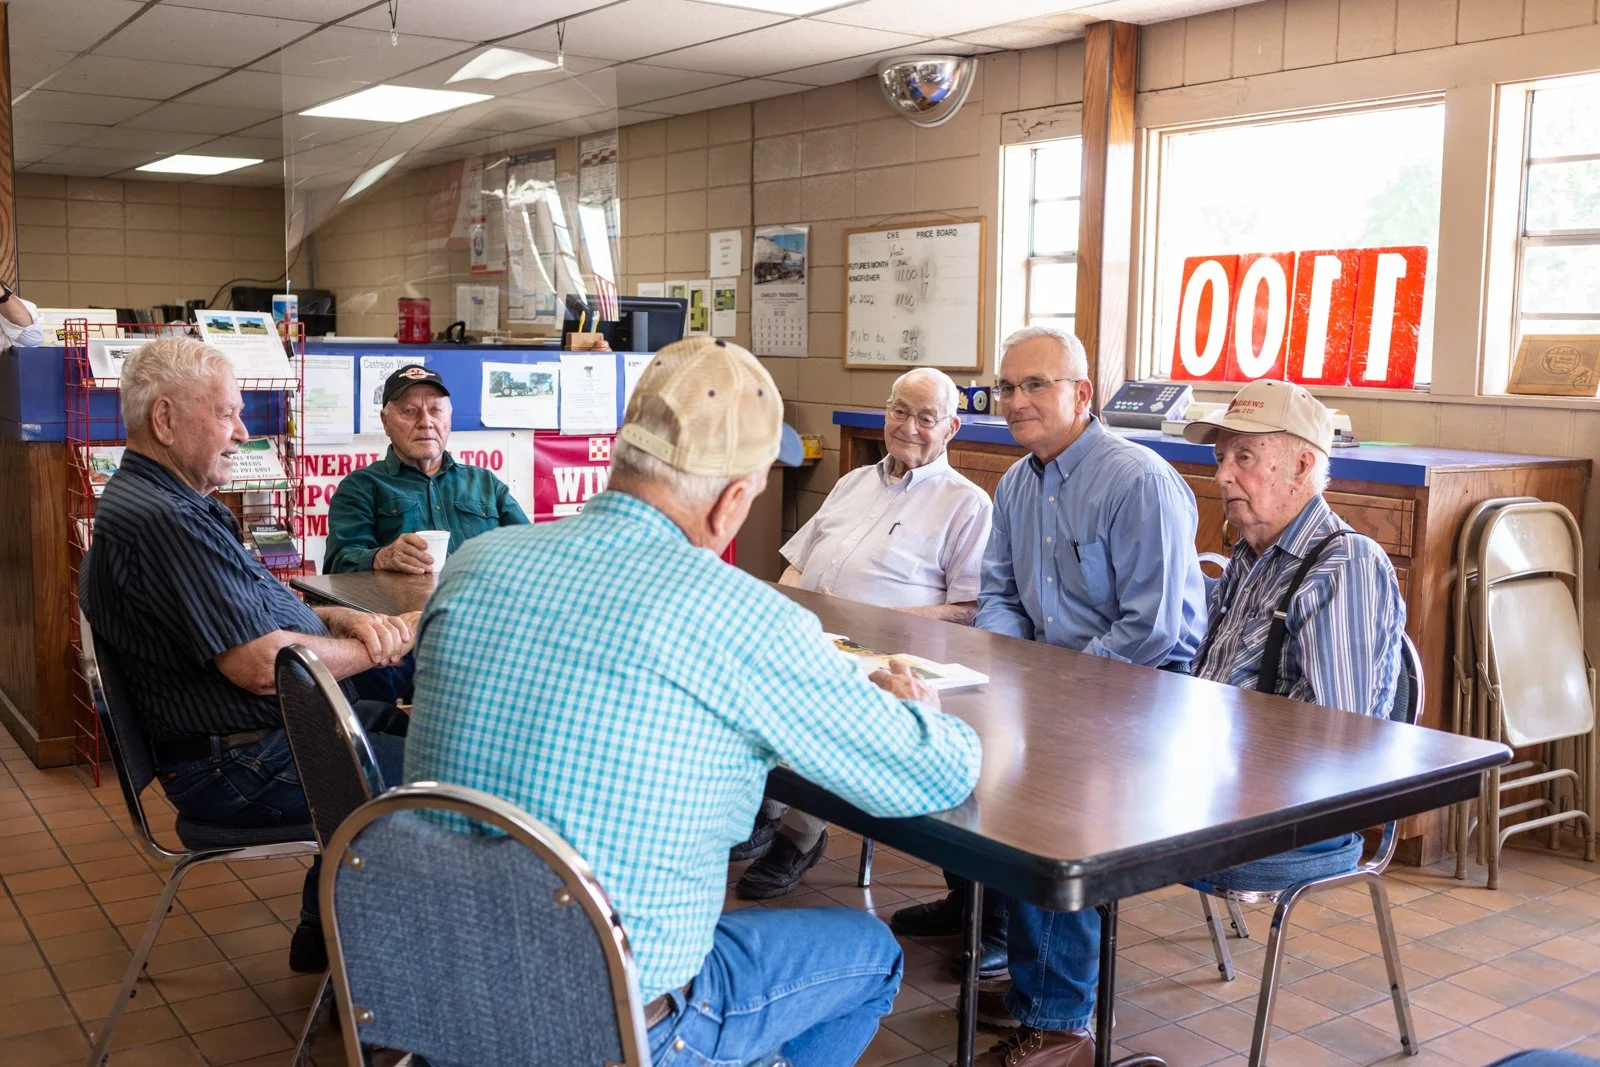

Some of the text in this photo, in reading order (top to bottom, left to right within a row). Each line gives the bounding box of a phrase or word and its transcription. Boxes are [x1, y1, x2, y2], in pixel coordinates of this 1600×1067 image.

[886, 229, 957, 239] CHS PRICE BOARD
[849, 262, 871, 270] FUTURES
[459, 449, 503, 471] TOO
